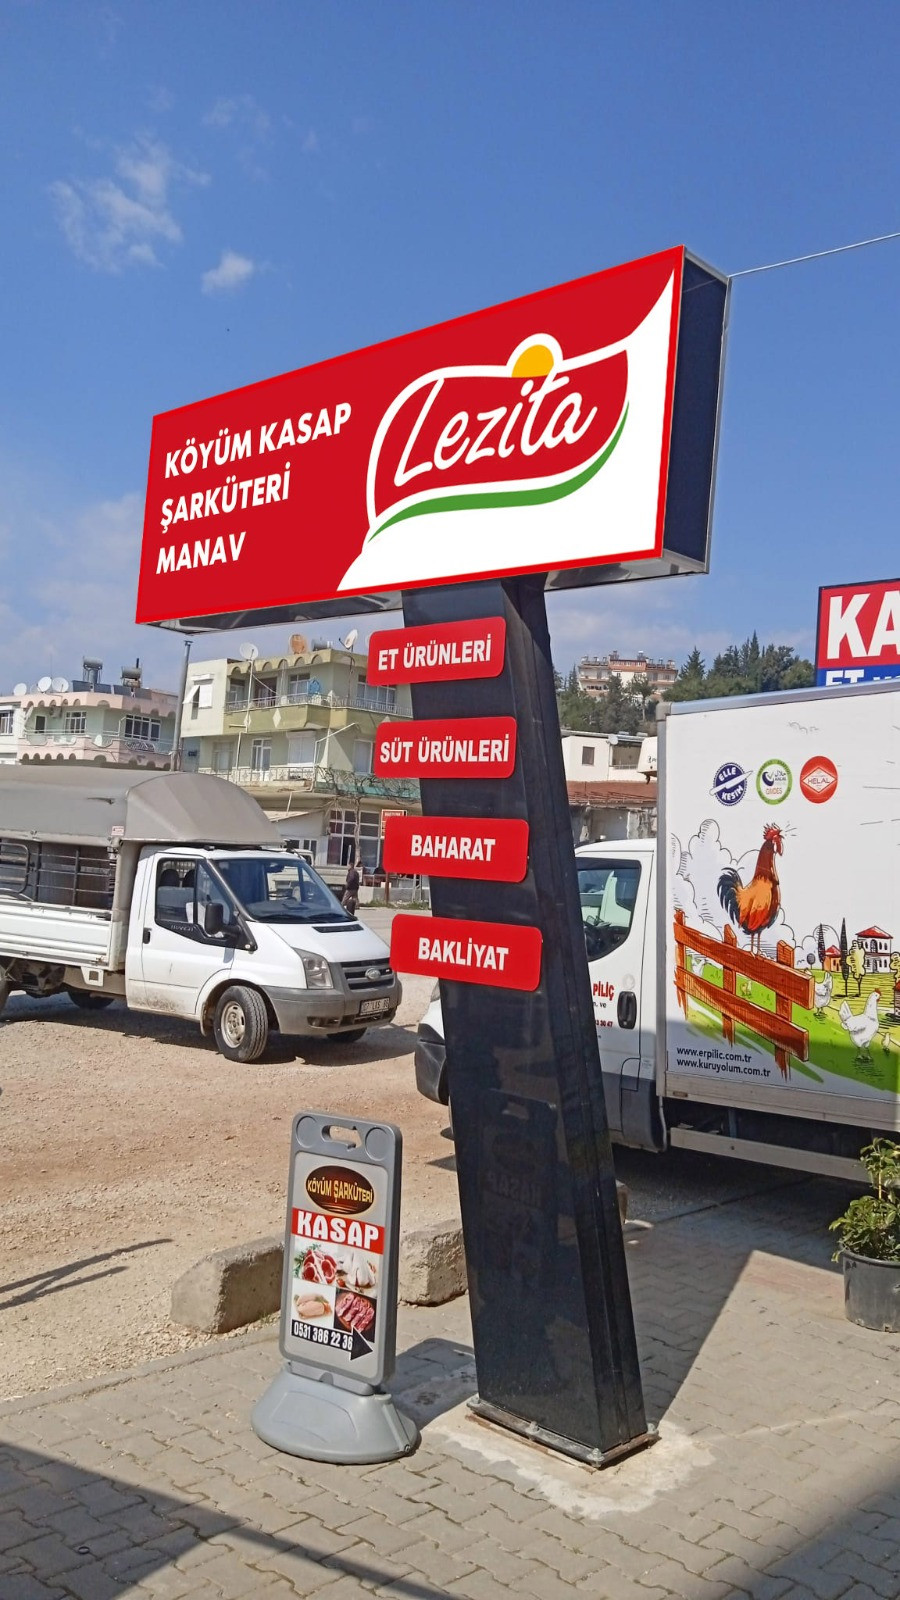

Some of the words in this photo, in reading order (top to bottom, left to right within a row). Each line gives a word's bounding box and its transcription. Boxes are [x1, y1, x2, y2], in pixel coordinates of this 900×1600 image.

[164, 427, 252, 479] KÖYÜM
[258, 402, 352, 454] KASAP
[393, 372, 598, 487] Lezita
[160, 461, 291, 534] ŞARKÜTERİ
[156, 531, 247, 575] MANAV
[378, 648, 399, 671] ET
[403, 633, 492, 669] ÜRÜNLERİ
[379, 737, 413, 763] SÜT
[418, 733, 510, 763] ÜRÜNLERİ
[410, 834, 496, 862] BAHARAT
[418, 937, 509, 971] BAKLİYAT
[676, 1046, 752, 1064] www.erpilic.com.tr
[676, 1058, 771, 1078] www.kuruyolum.com.tr
[297, 1210, 379, 1250] KASAP
[293, 1321, 312, 1340] 0531
[330, 1331, 341, 1348] 22
